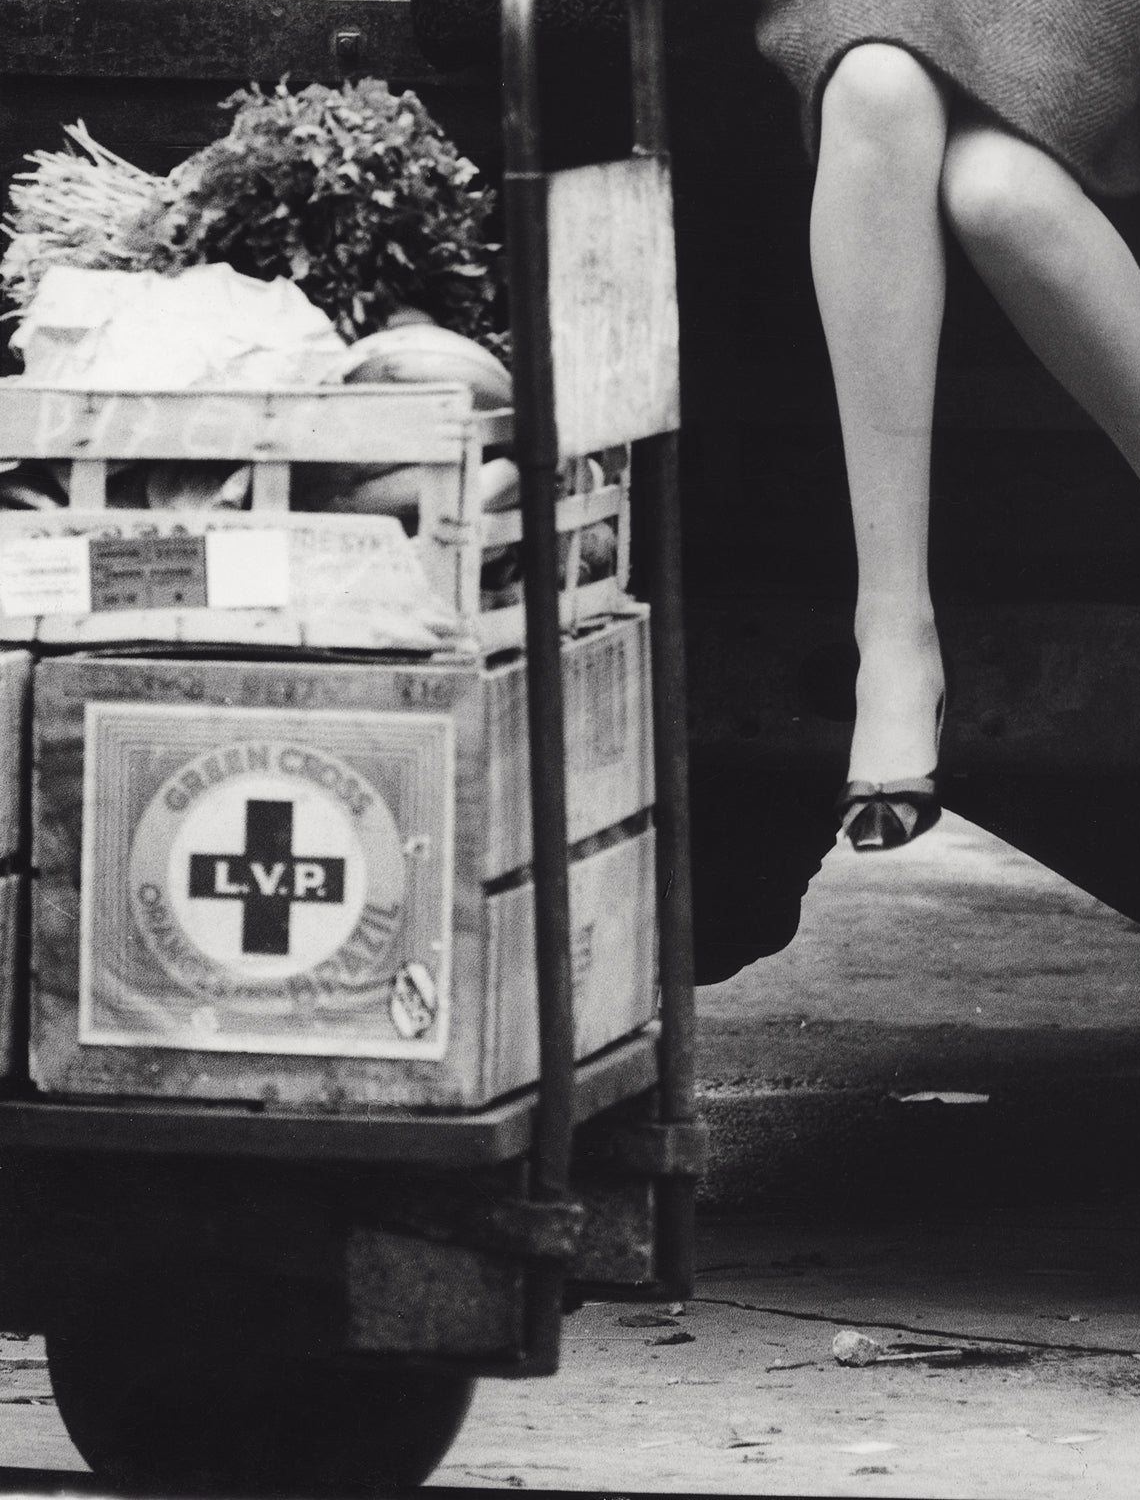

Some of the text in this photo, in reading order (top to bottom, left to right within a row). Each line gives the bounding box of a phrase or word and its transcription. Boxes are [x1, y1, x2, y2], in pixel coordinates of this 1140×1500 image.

[163, 745, 374, 817] GREEN CROSS
[213, 859, 327, 898] L.V.P.
